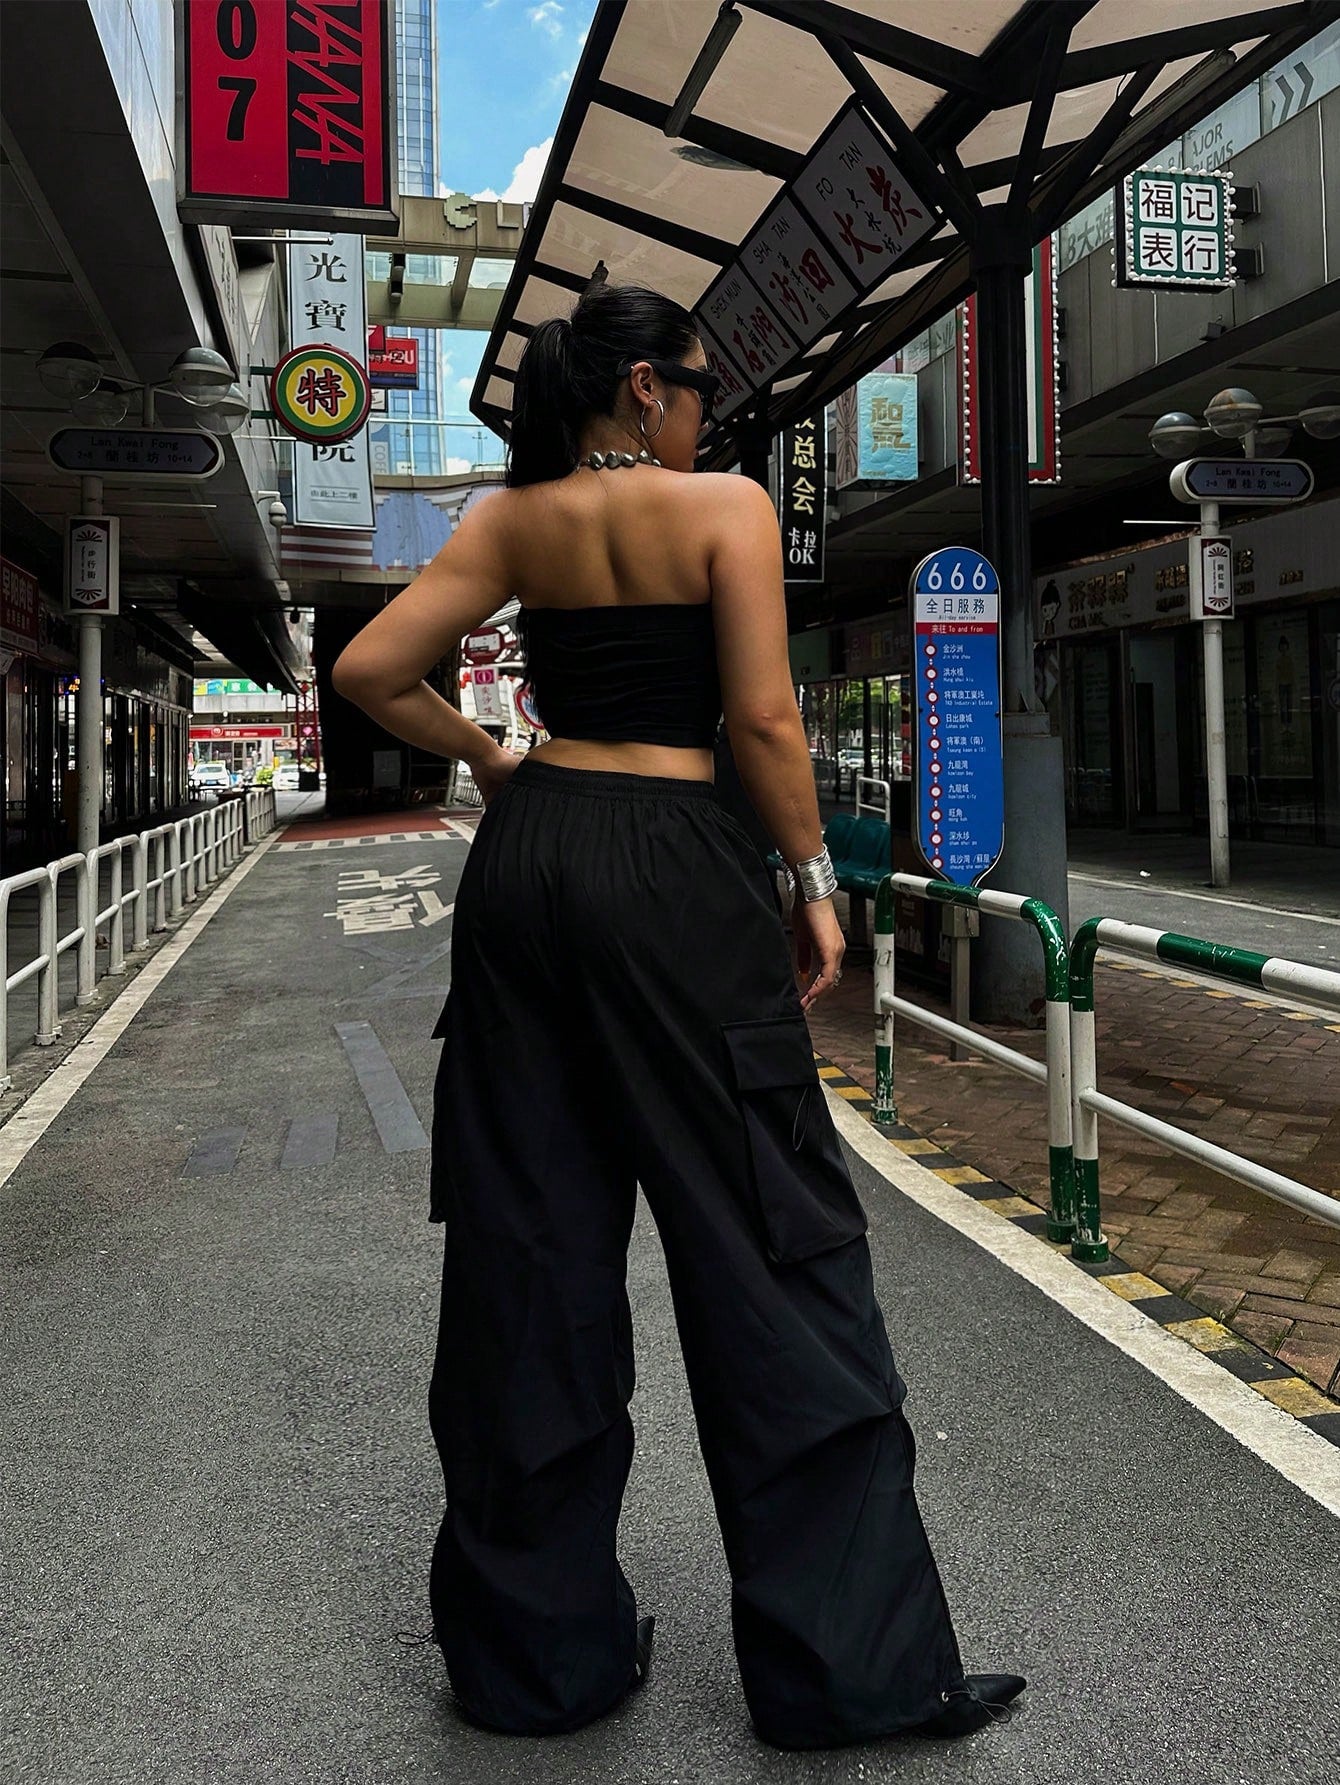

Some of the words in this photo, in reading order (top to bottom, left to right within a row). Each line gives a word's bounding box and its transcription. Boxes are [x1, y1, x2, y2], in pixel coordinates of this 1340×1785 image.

[815, 177, 835, 201] FO
[839, 141, 864, 172] TAN
[1141, 181, 1215, 222] 福记
[752, 240, 772, 265] SHA
[771, 216, 791, 240] TAN
[1141, 231, 1216, 271] 表行
[296, 367, 347, 417] 特
[91, 436, 112, 447] Lan
[118, 438, 144, 448] Kwai
[152, 439, 179, 450] Fong
[1216, 467, 1232, 476] Lan
[1260, 468, 1281, 478] Fong
[788, 527, 817, 549] 卡拉
[789, 549, 815, 565] OK
[928, 562, 987, 591] 666
[926, 597, 985, 614] 全日服務
